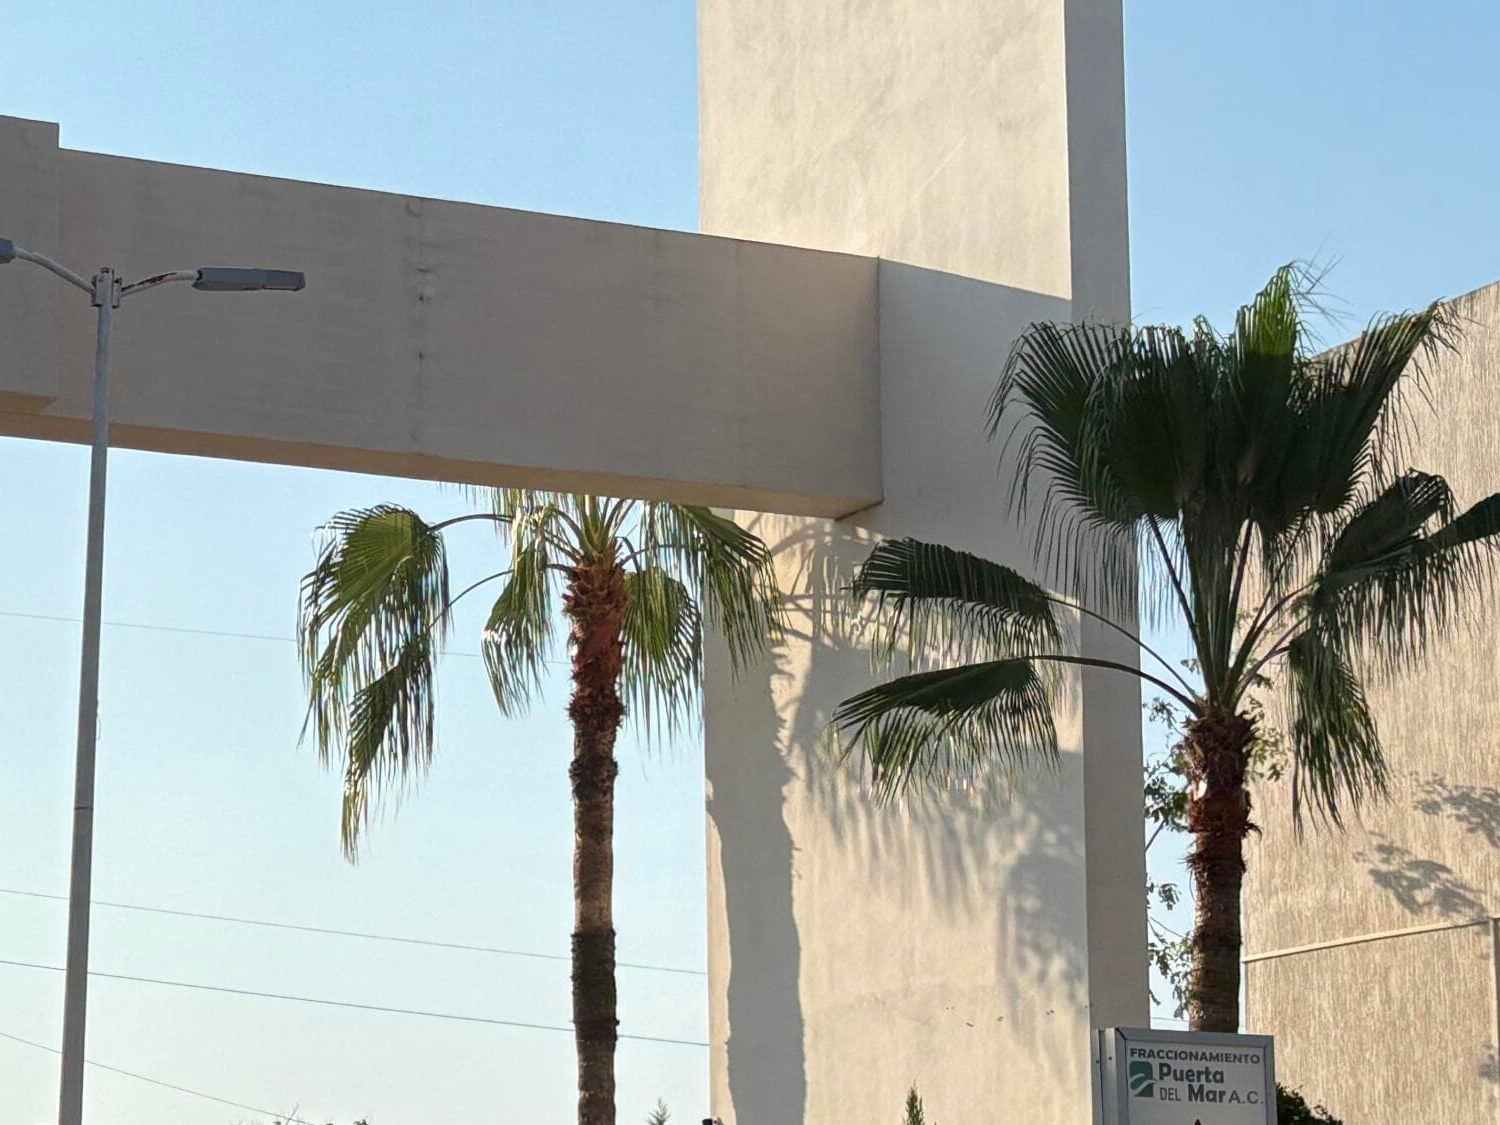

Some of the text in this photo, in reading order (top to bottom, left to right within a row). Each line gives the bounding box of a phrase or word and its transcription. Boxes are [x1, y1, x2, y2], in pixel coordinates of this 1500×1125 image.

[1129, 1048, 1261, 1064] FRACCIONAMIENTO
[1158, 1062, 1224, 1083] Puerta
[1159, 1084, 1264, 1105] DEL Mar A.C.
